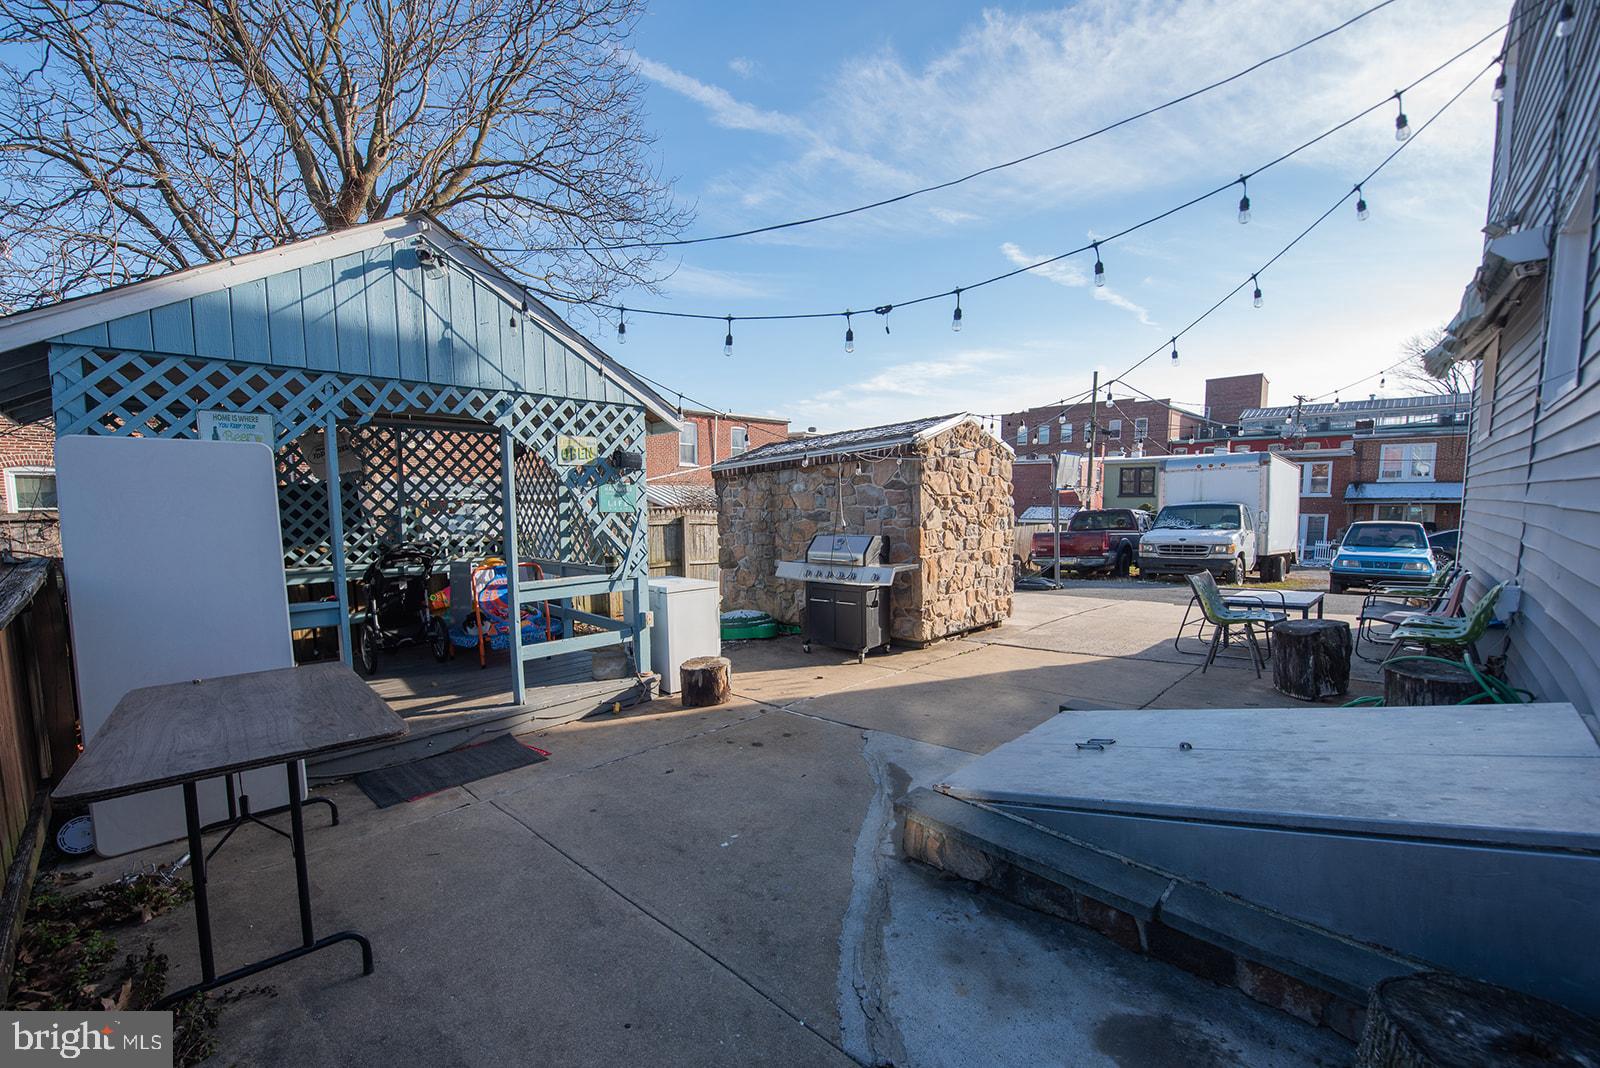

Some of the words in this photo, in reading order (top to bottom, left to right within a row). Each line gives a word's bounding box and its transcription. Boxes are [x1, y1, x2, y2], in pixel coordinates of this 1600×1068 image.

[213, 413, 231, 421] HOME
[238, 415, 259, 423] WHERE
[561, 446, 593, 461] OPEN
